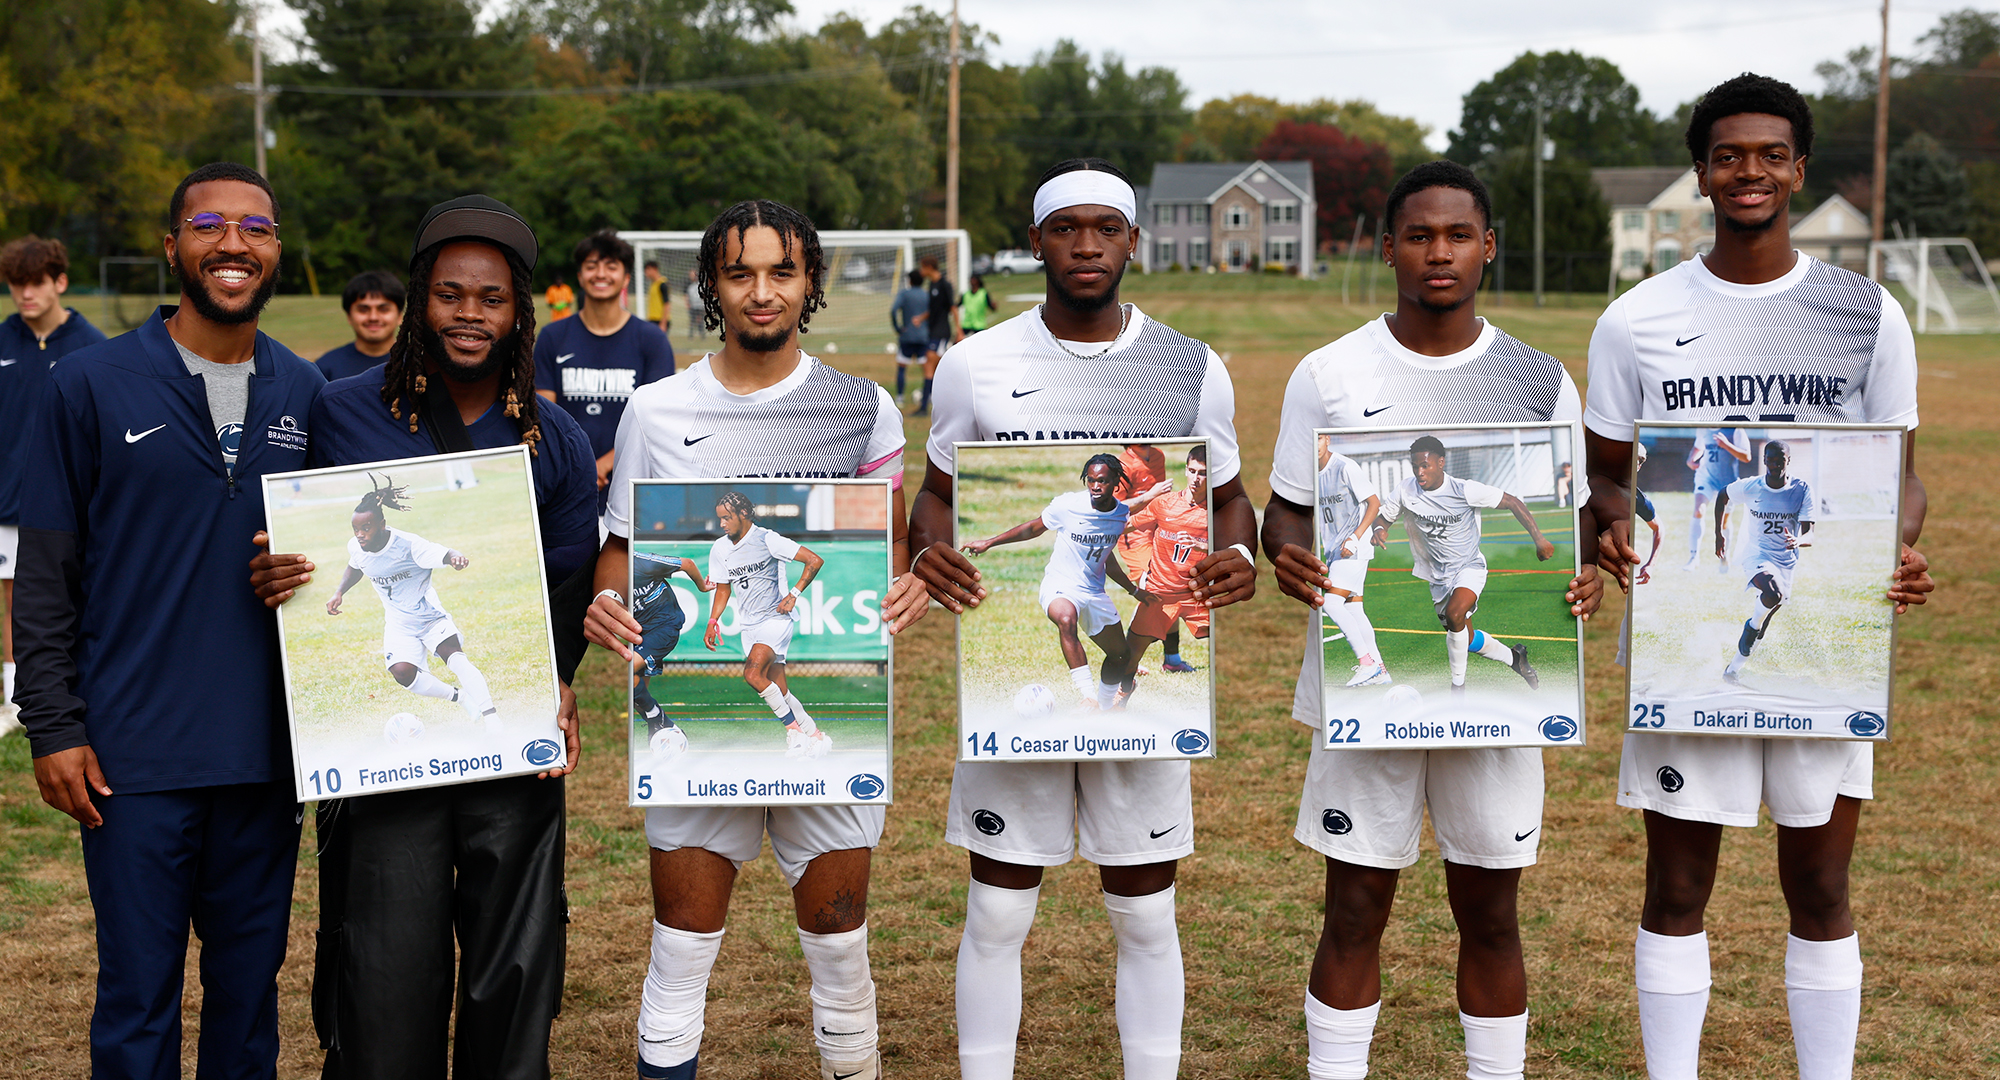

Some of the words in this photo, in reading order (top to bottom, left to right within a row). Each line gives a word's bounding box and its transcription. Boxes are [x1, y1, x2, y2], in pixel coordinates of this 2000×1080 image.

[1662, 374, 1847, 411] BRANDYWINE
[1708, 450, 1719, 462] 21
[1750, 509, 1796, 519] BRANDYWIN
[1426, 523, 1447, 539] 22
[1763, 521, 1784, 534] 25
[1071, 533, 1120, 545] BRANDYWIN
[1086, 545, 1104, 563] 14
[1172, 543, 1192, 565] 17
[739, 575, 749, 590] 5
[381, 586, 393, 601] 7
[1633, 703, 1666, 728] 25
[1693, 710, 1748, 728] Dakari
[1753, 712, 1812, 730] Burton
[1328, 718, 1361, 743] 22
[1385, 721, 1445, 739] Robbie
[1449, 721, 1511, 738] Warren
[967, 731, 998, 756] 14
[1011, 736, 1069, 753] Ceasar
[1074, 734, 1156, 756] Ugwuanyi
[308, 767, 342, 795] 10
[358, 762, 424, 786] Francis
[429, 753, 502, 777] Sarpong
[637, 775, 653, 800] 5
[687, 779, 738, 797] Lukas
[743, 778, 826, 797] Garthwait
